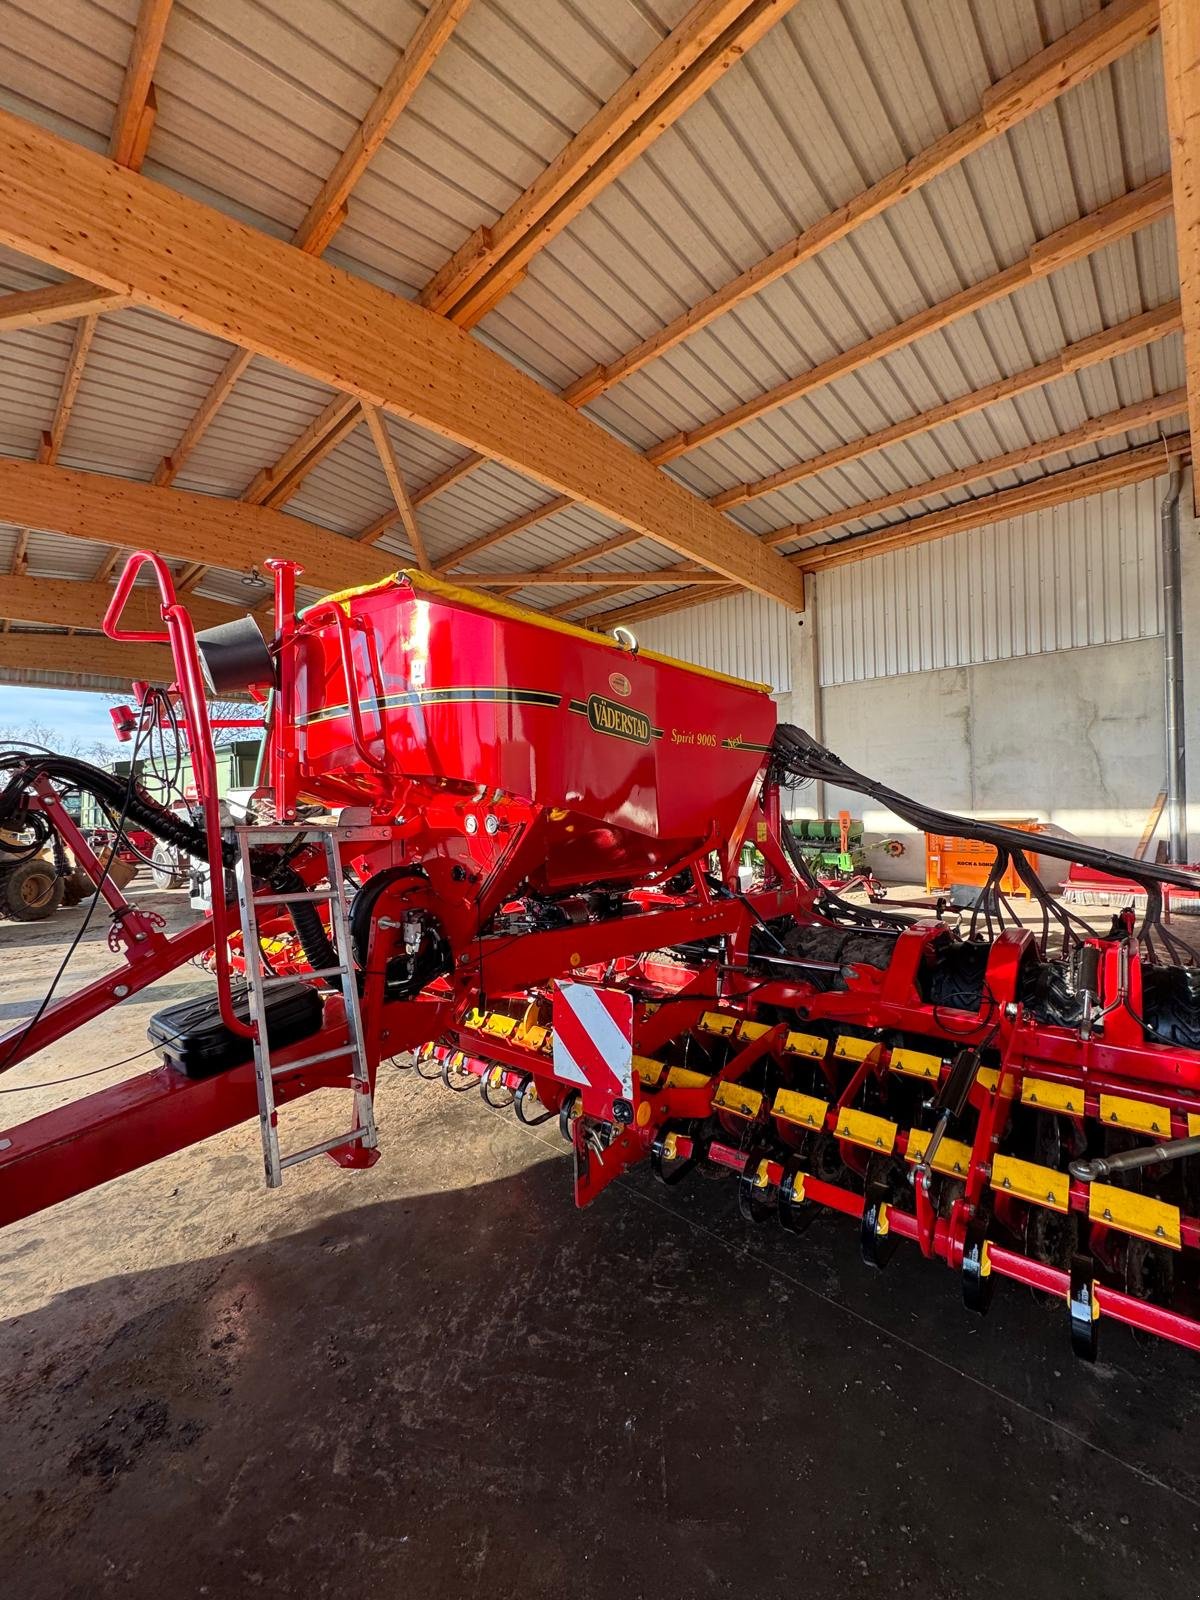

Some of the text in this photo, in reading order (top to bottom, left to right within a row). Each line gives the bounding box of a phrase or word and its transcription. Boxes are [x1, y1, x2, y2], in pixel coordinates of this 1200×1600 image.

[593, 700, 648, 739] VÄDERSTAD
[671, 728, 717, 747] Spirit 900S
